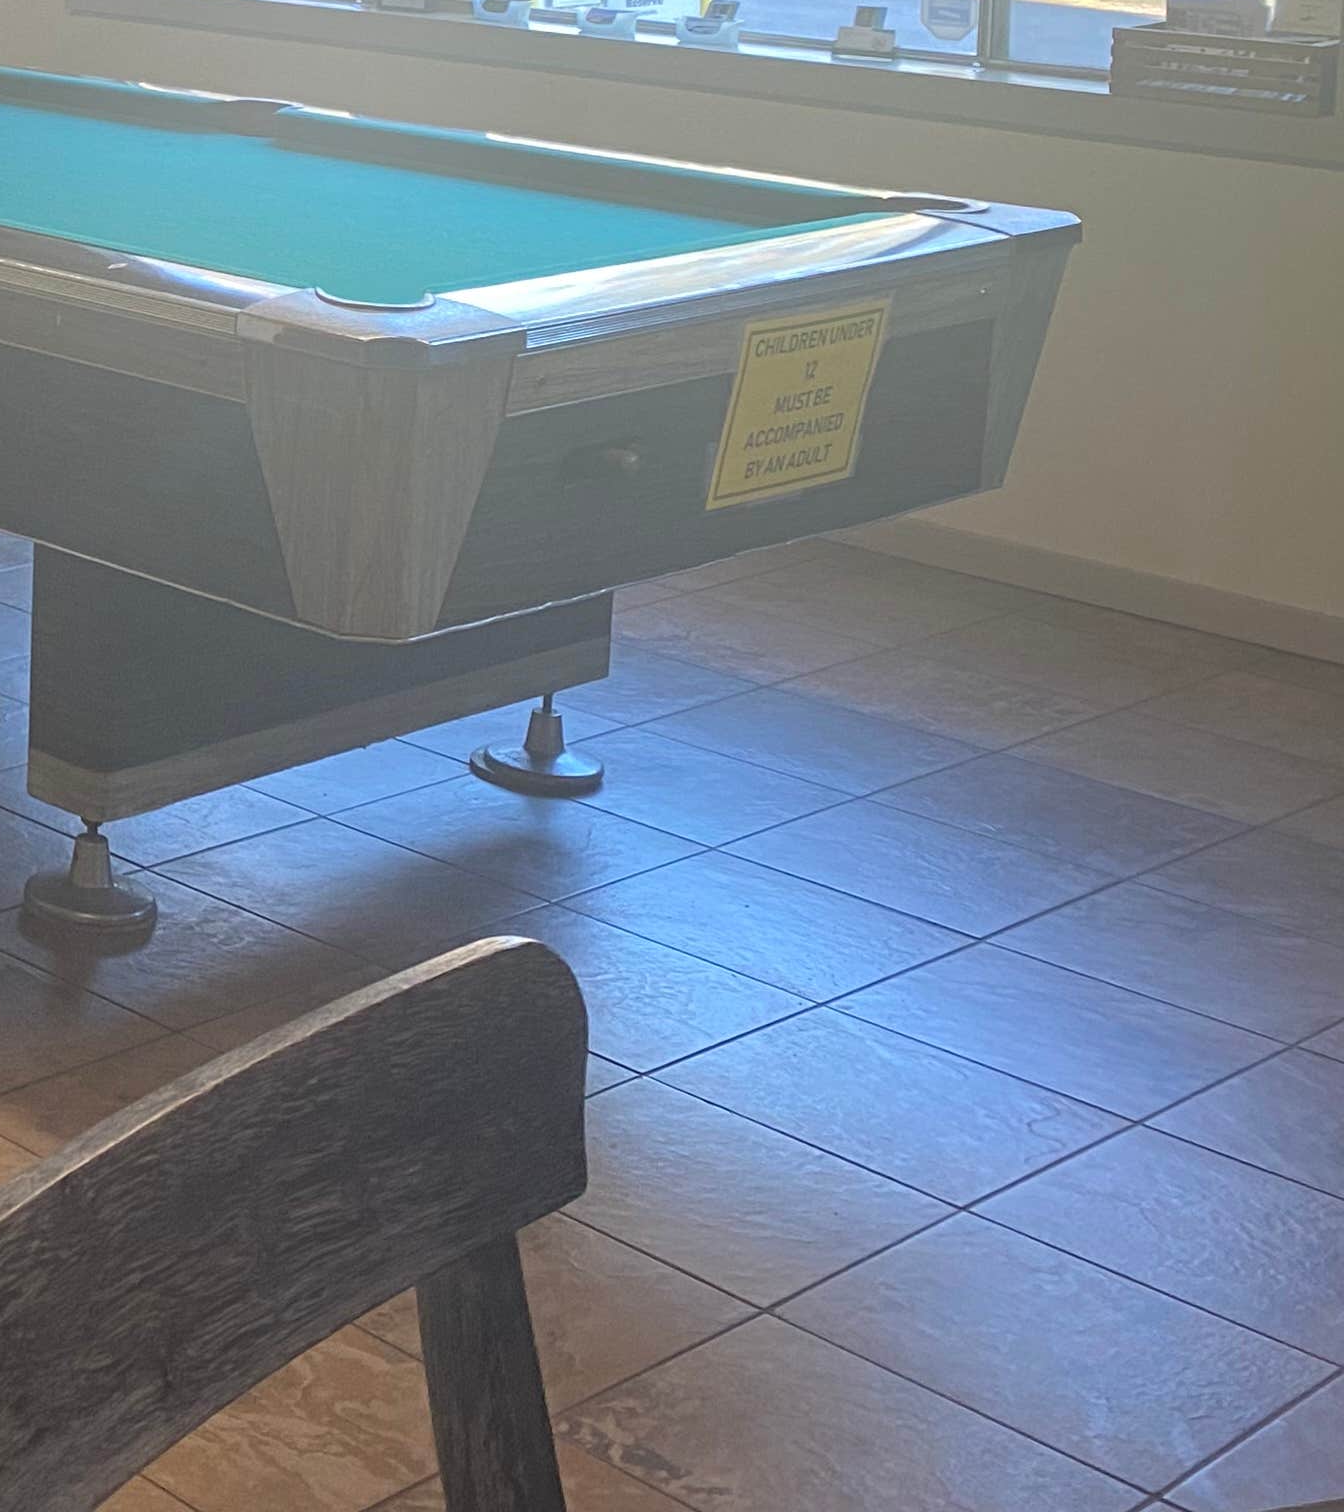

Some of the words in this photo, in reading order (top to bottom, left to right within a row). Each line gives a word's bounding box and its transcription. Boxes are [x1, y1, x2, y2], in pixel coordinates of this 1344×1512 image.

[755, 328, 828, 357] CHILDREN
[830, 319, 874, 345] UNDER
[774, 390, 814, 414] MUST
[814, 386, 833, 406] BE
[744, 413, 844, 450] ACCOMPANIED
[744, 461, 765, 479] BY
[764, 455, 787, 473] AN
[786, 444, 832, 468] ADULT
